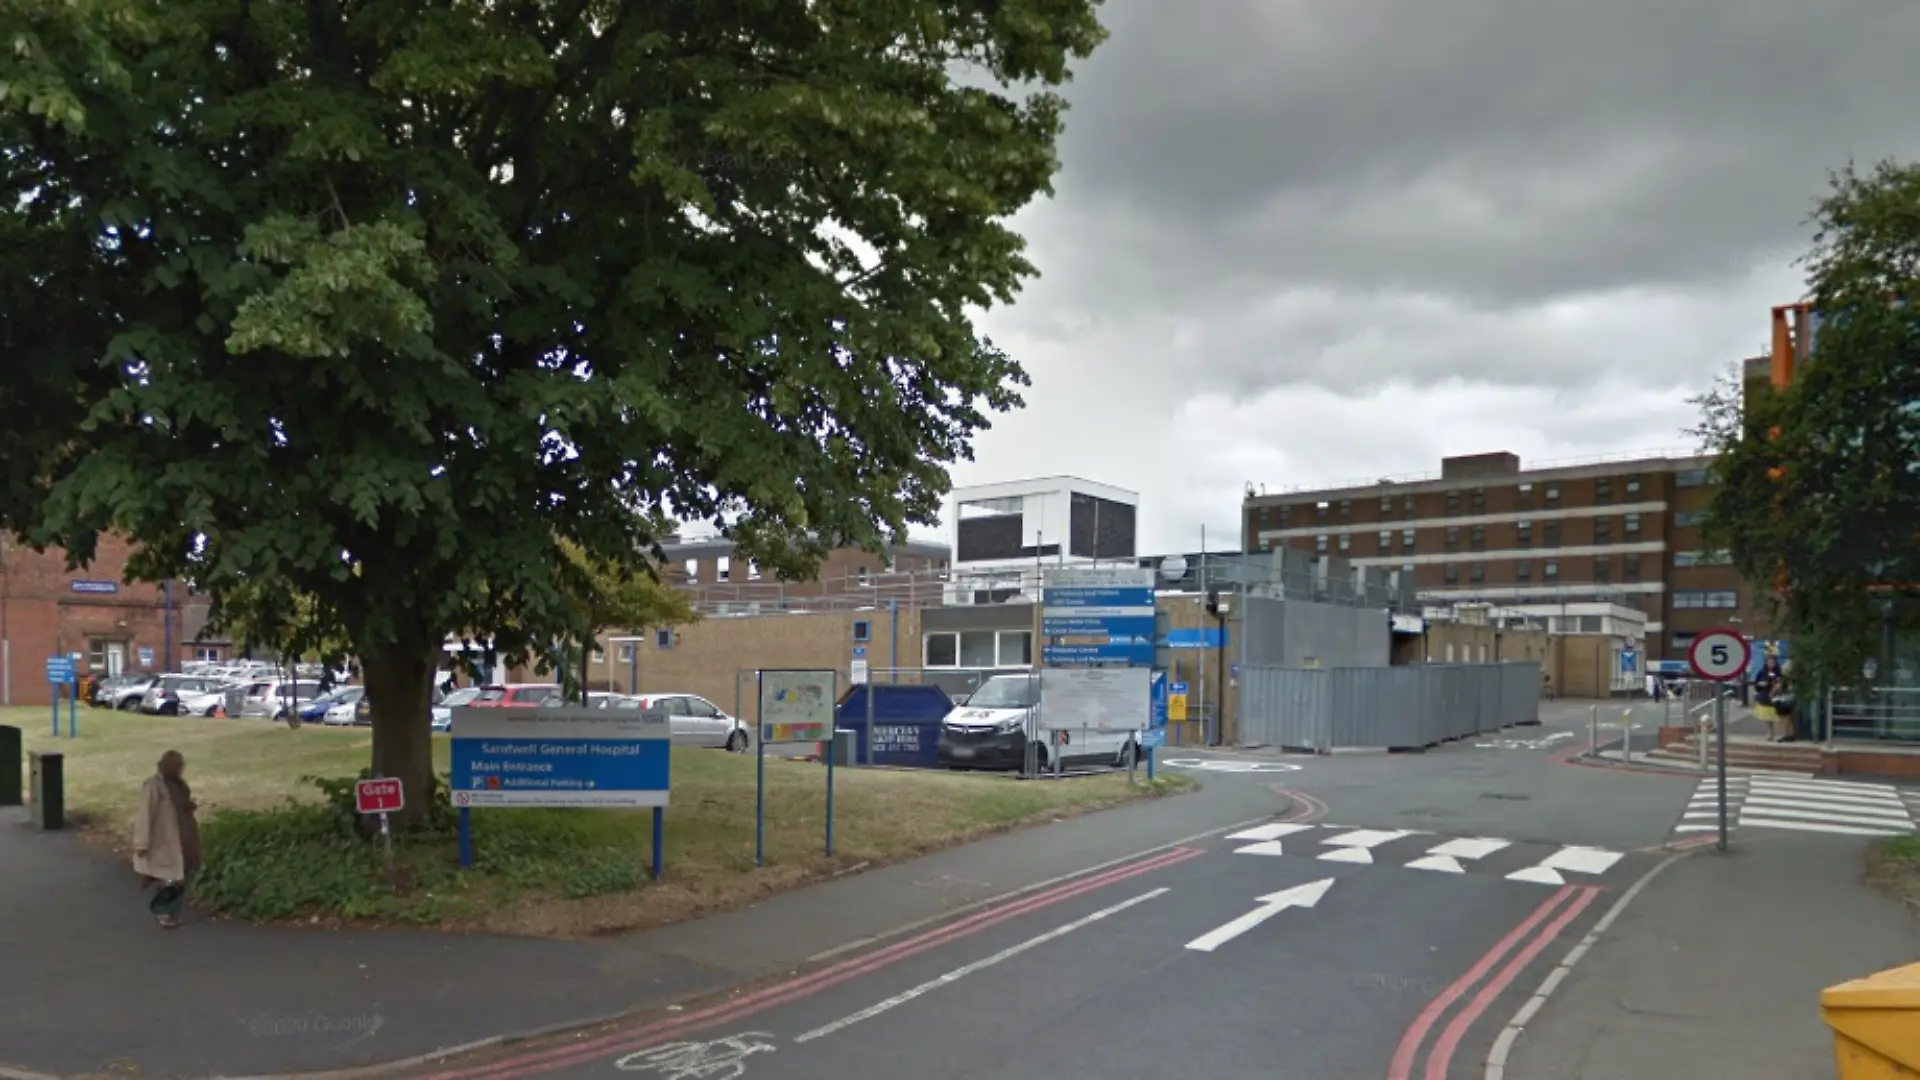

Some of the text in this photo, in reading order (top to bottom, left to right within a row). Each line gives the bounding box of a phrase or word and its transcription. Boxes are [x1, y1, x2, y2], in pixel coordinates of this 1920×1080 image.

[1711, 644, 1729, 666] 5
[481, 743, 640, 757] Sandwell General Hospital
[471, 760, 554, 773] Main Entrance
[362, 783, 396, 797] Gate
[503, 777, 549, 788] Additional
[550, 778, 584, 790] Parking
[377, 797, 385, 809] 1
